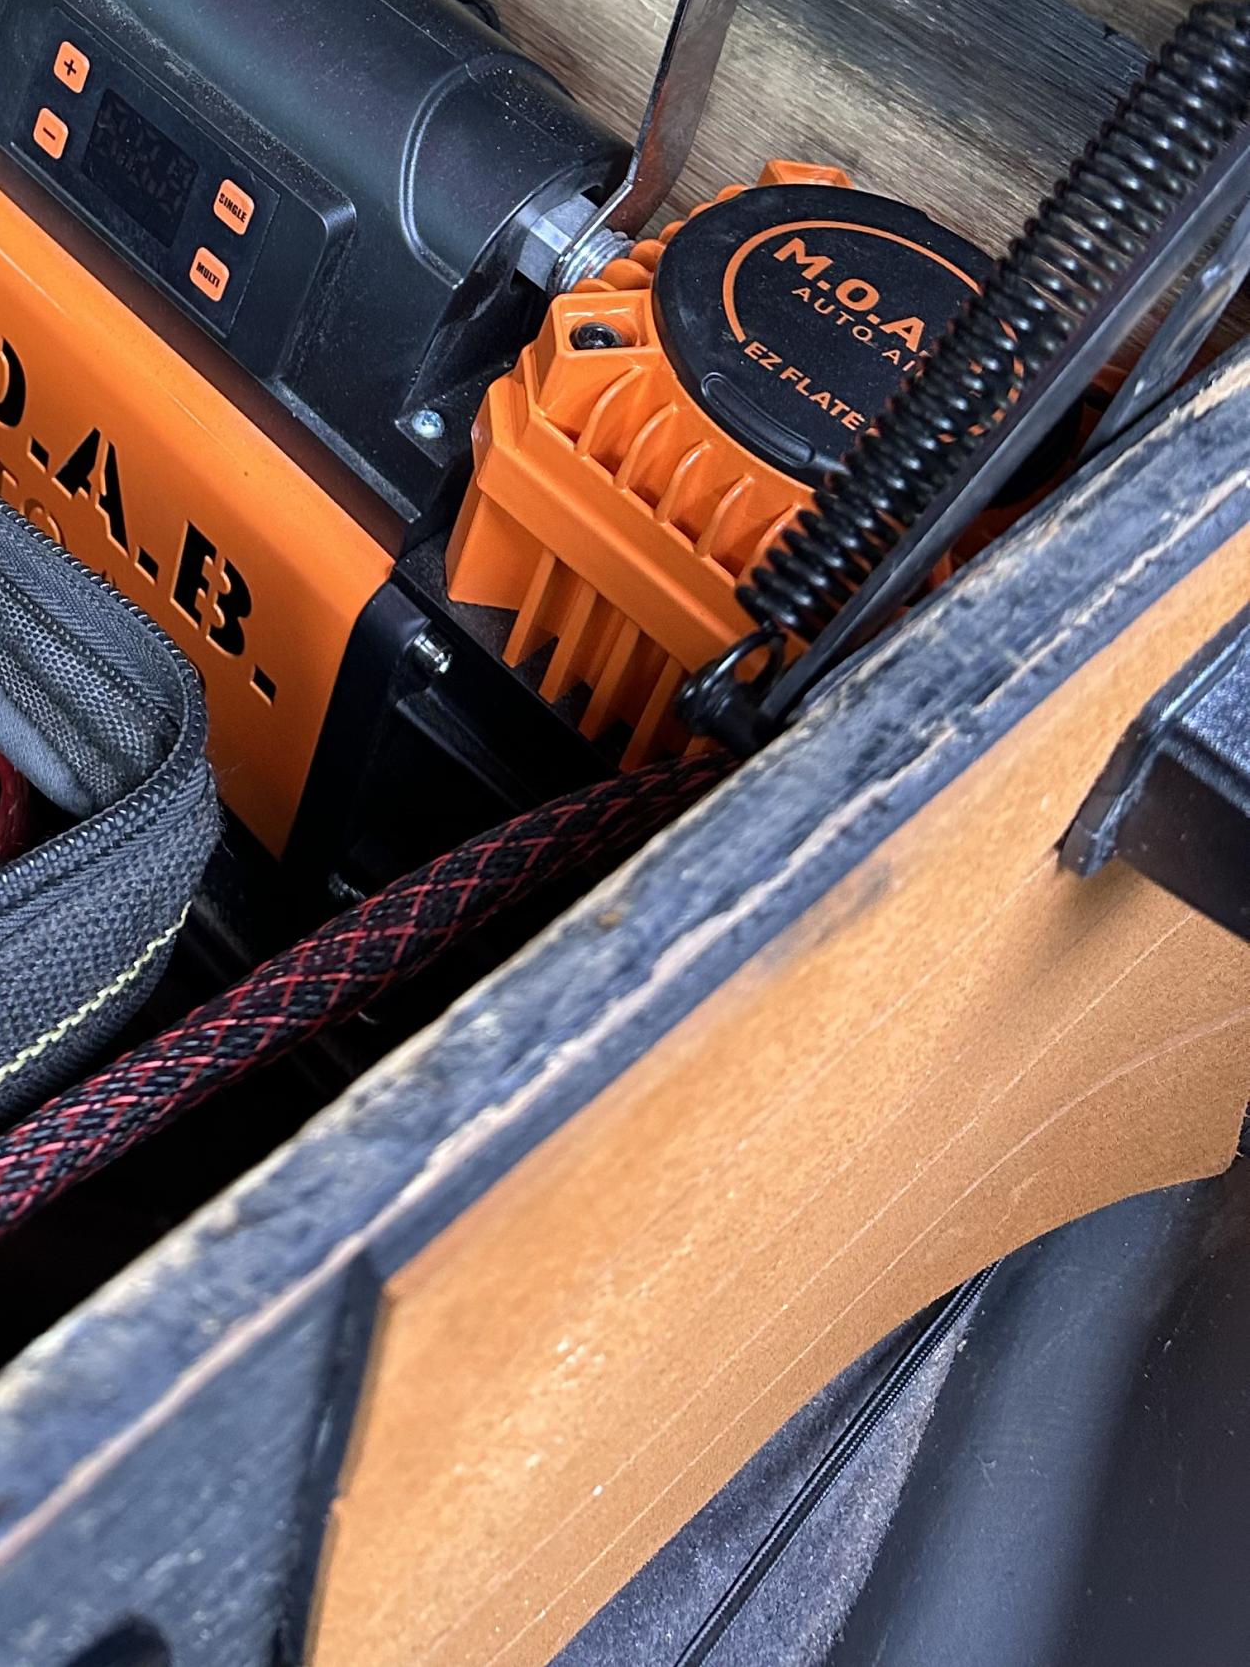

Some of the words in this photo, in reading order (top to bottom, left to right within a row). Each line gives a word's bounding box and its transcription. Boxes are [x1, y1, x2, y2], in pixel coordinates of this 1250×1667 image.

[218, 192, 248, 224] SINGLE
[196, 261, 221, 289] MULTI
[773, 237, 933, 360] M.O.A.
[791, 286, 874, 343] AUTO
[881, 348, 924, 378] AI
[743, 340, 784, 372] EZ
[779, 365, 866, 432] FLATE
